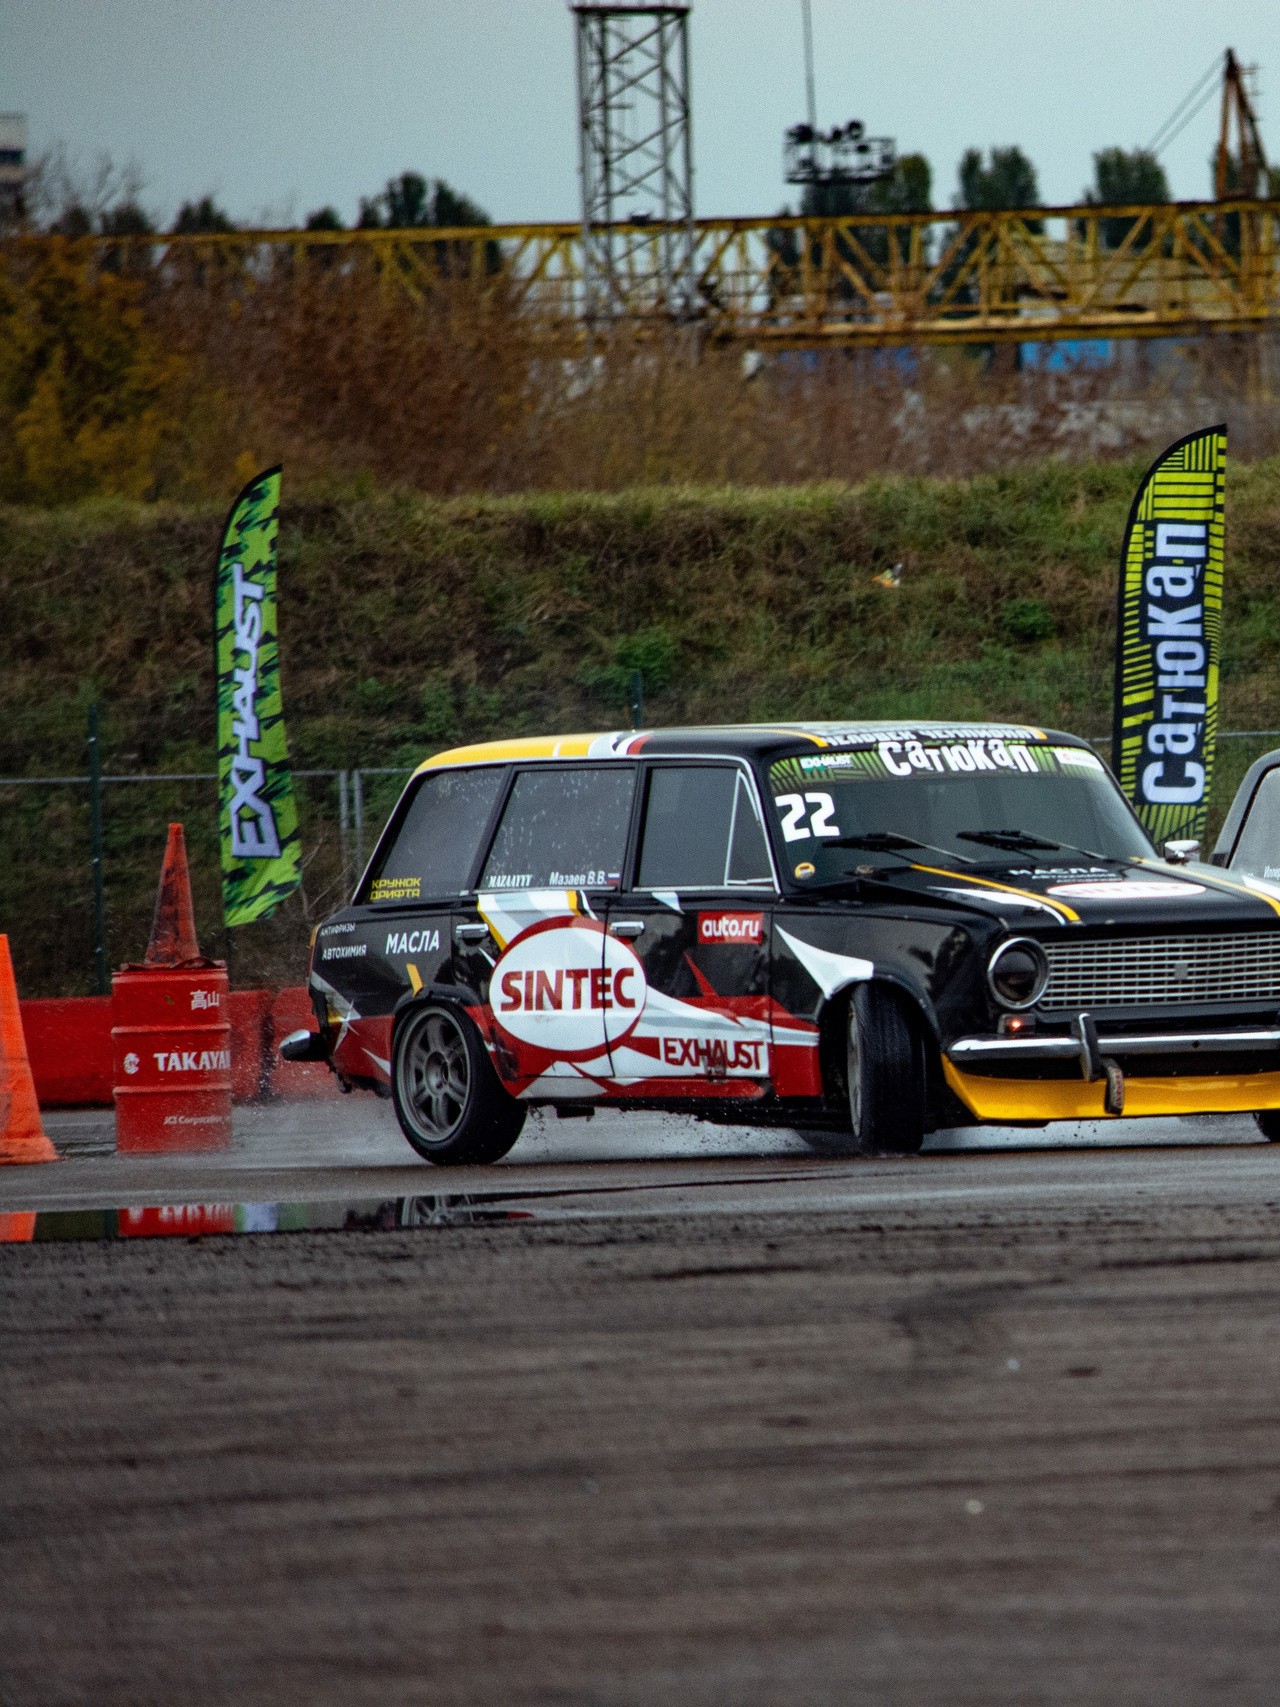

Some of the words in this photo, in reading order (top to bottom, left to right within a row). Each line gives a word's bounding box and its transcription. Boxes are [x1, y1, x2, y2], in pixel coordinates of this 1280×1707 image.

[230, 563, 281, 857] EXHAUST
[775, 792, 840, 842] 22
[371, 877, 421, 890] КРУЖОК
[549, 871, 587, 886] Мазаев
[369, 888, 421, 901] ДРИФТА
[702, 917, 759, 938] auto.ru
[322, 944, 367, 961] АВТОХИМИЯ
[385, 930, 440, 955] МАСЛА
[190, 989, 220, 1010] 高山
[500, 967, 636, 1012] SINTEC
[663, 1037, 764, 1070] EXHAUST
